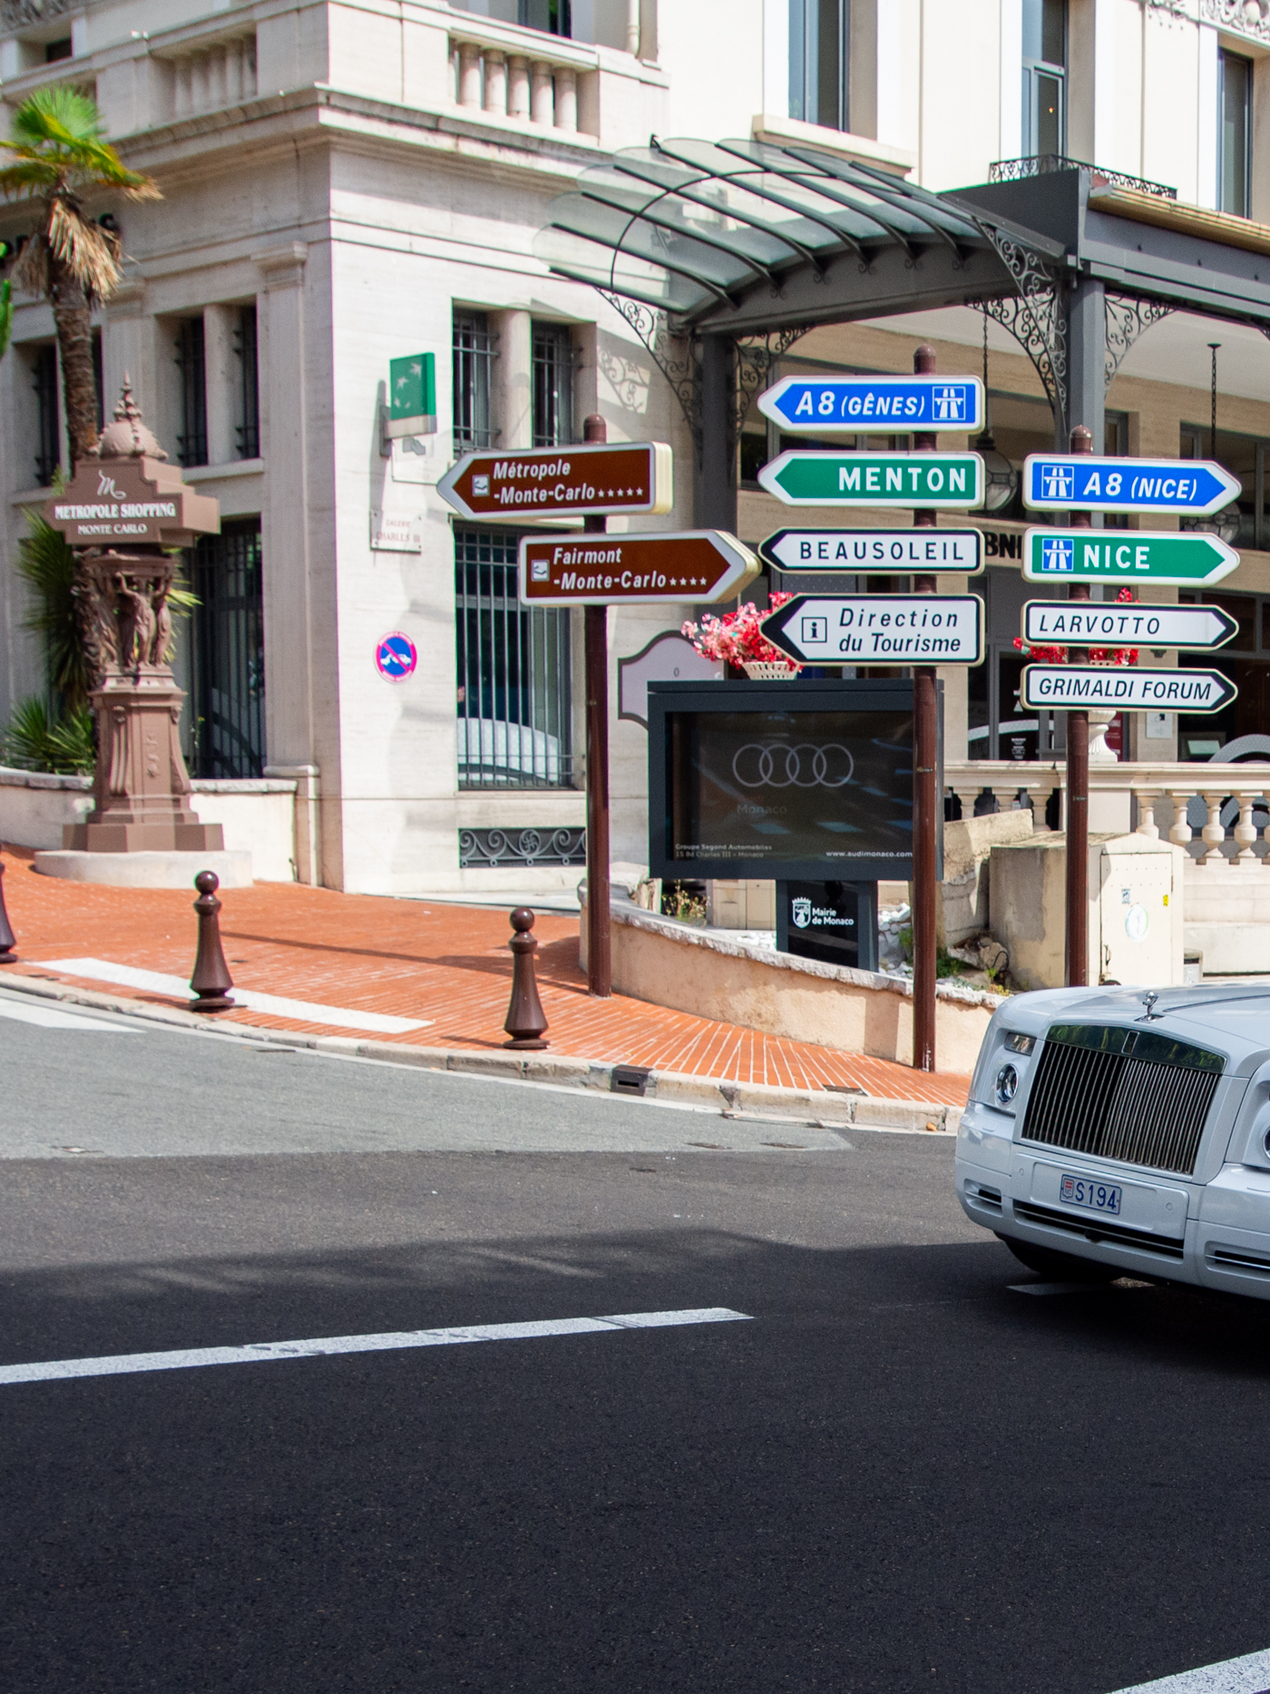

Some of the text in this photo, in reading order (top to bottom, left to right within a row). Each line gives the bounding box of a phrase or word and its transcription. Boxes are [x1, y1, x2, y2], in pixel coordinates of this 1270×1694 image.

[841, 392, 925, 417] (GÊNES)
[493, 458, 571, 481] Métropole
[838, 466, 966, 492] MENTON
[1131, 476, 1197, 501] (NICE)
[55, 503, 176, 519] METROPOLE SHOPPING
[78, 524, 147, 535] MONTE CARLO
[553, 547, 622, 565] Fairmont
[800, 541, 964, 560] BEAUSOLEIL
[1083, 544, 1150, 569] NICE
[839, 607, 958, 627] Direction
[1039, 614, 1160, 635] LARVOTTO
[839, 633, 961, 652] du Tourisme
[1039, 678, 1211, 700] GRIMALDI FORUM
[737, 804, 788, 814] Monaco
[675, 843, 700, 851] Groupe
[728, 843, 773, 851] Automobiles
[812, 907, 837, 917] Mairie
[812, 916, 855, 926] de Monaco
[1075, 1182, 1117, 1210] S194
